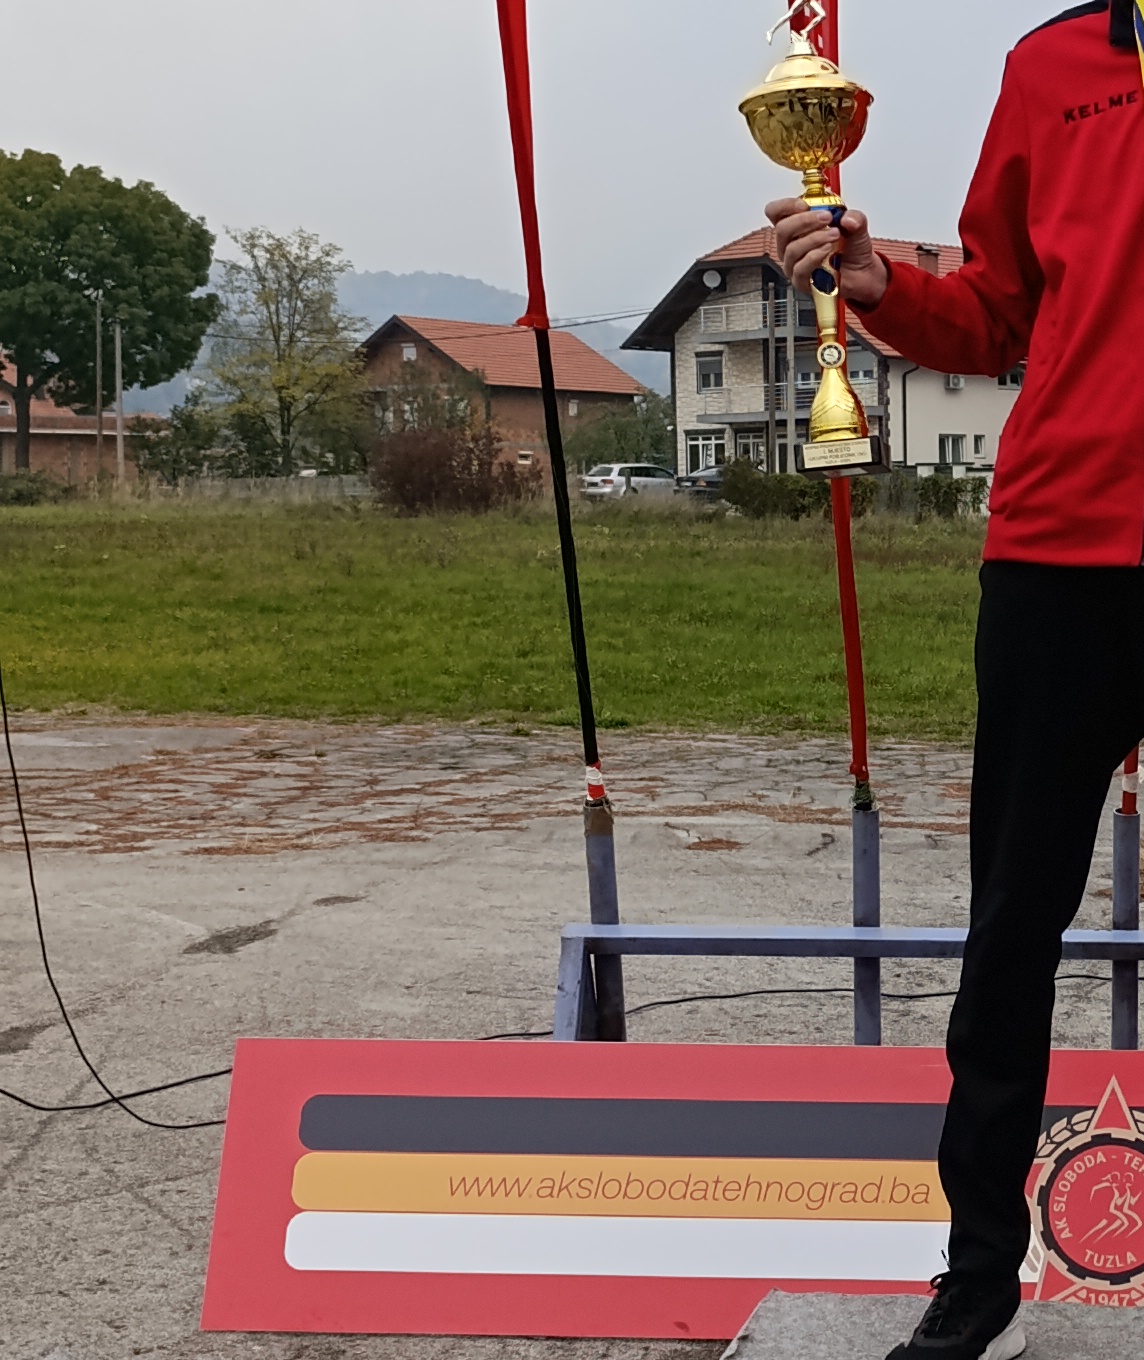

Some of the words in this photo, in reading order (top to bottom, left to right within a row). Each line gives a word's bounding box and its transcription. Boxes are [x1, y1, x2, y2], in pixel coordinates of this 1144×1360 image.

[1063, 89, 1138, 125] KELME
[448, 1170, 931, 1211] www.akslobodatehnograd.ba
[1053, 1151, 1107, 1213] SLOBODA
[1055, 1216, 1073, 1240] AK
[1084, 1249, 1137, 1268] TUZLA
[1088, 1292, 1131, 1307] 1947
